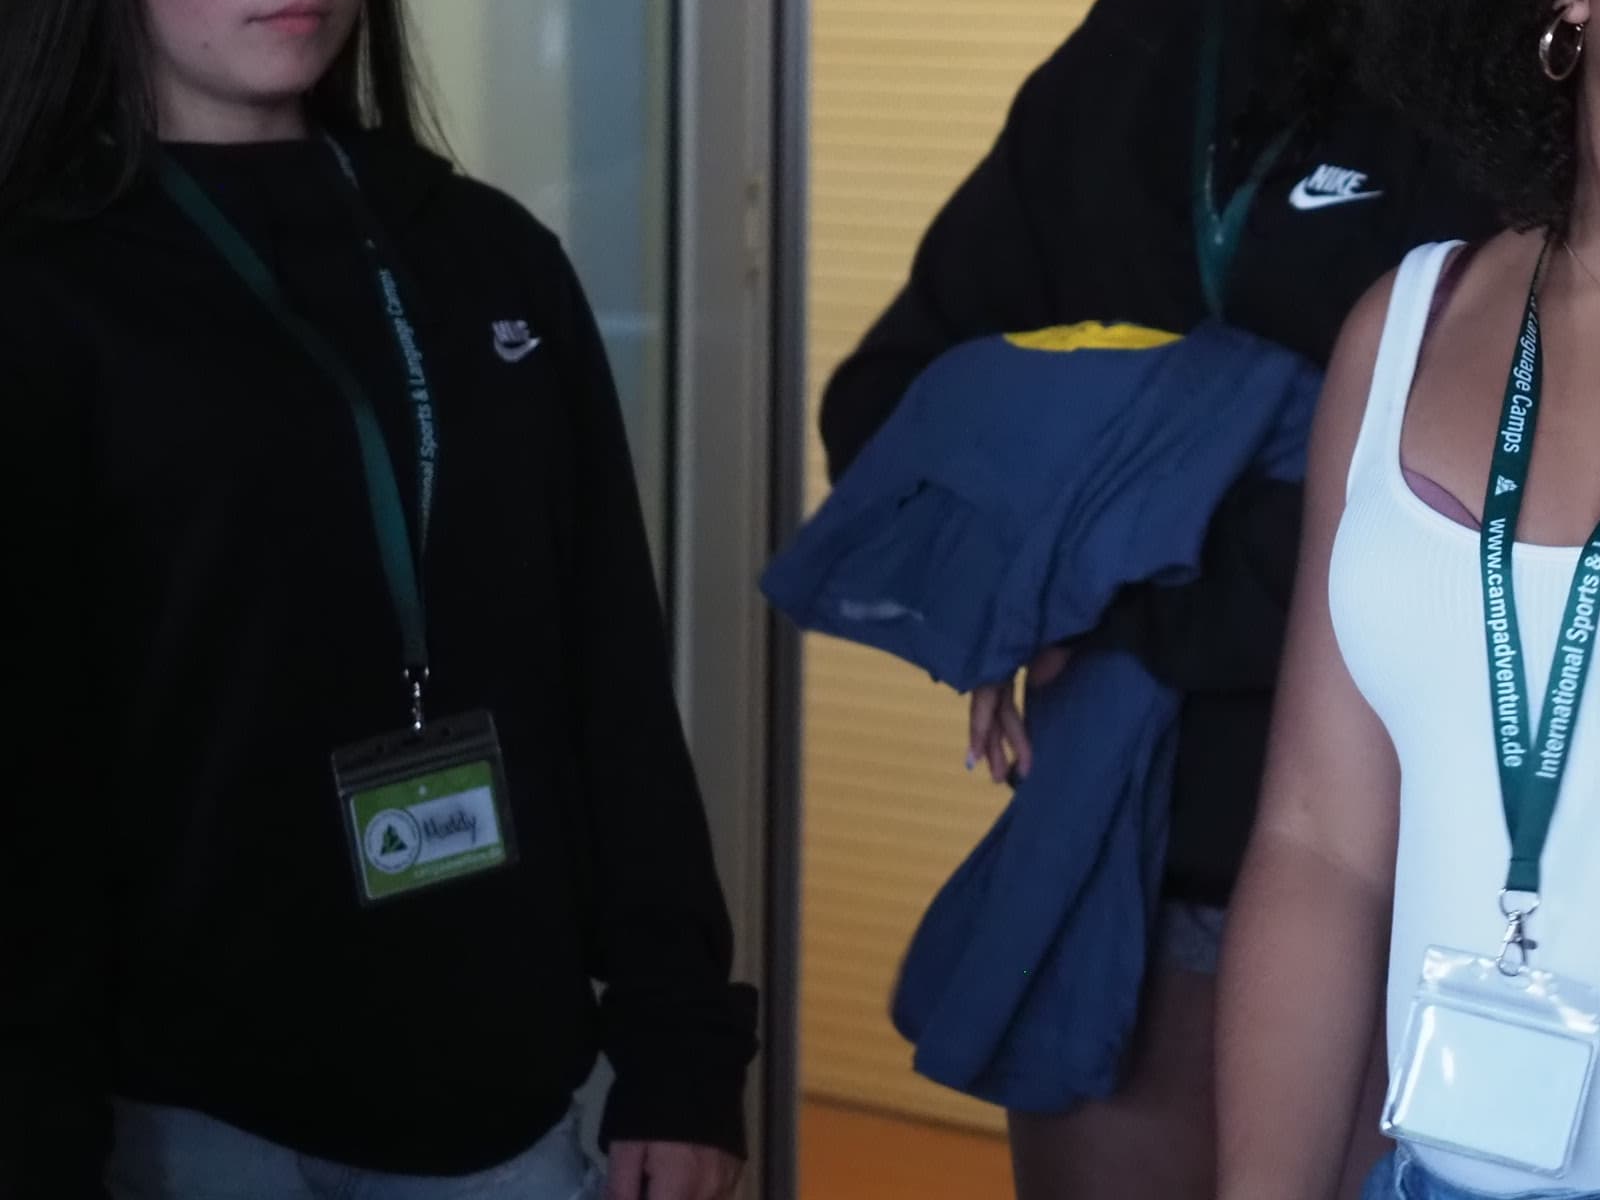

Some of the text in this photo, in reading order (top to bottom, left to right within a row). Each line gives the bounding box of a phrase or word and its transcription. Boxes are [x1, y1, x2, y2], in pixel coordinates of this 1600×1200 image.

[1306, 163, 1368, 196] NIKE
[416, 403, 438, 458] Sports
[1501, 312, 1539, 454] Language Camps
[1485, 517, 1526, 769] www.campadventure.de
[1535, 646, 1585, 780] International
[1566, 573, 1600, 645] Sports
